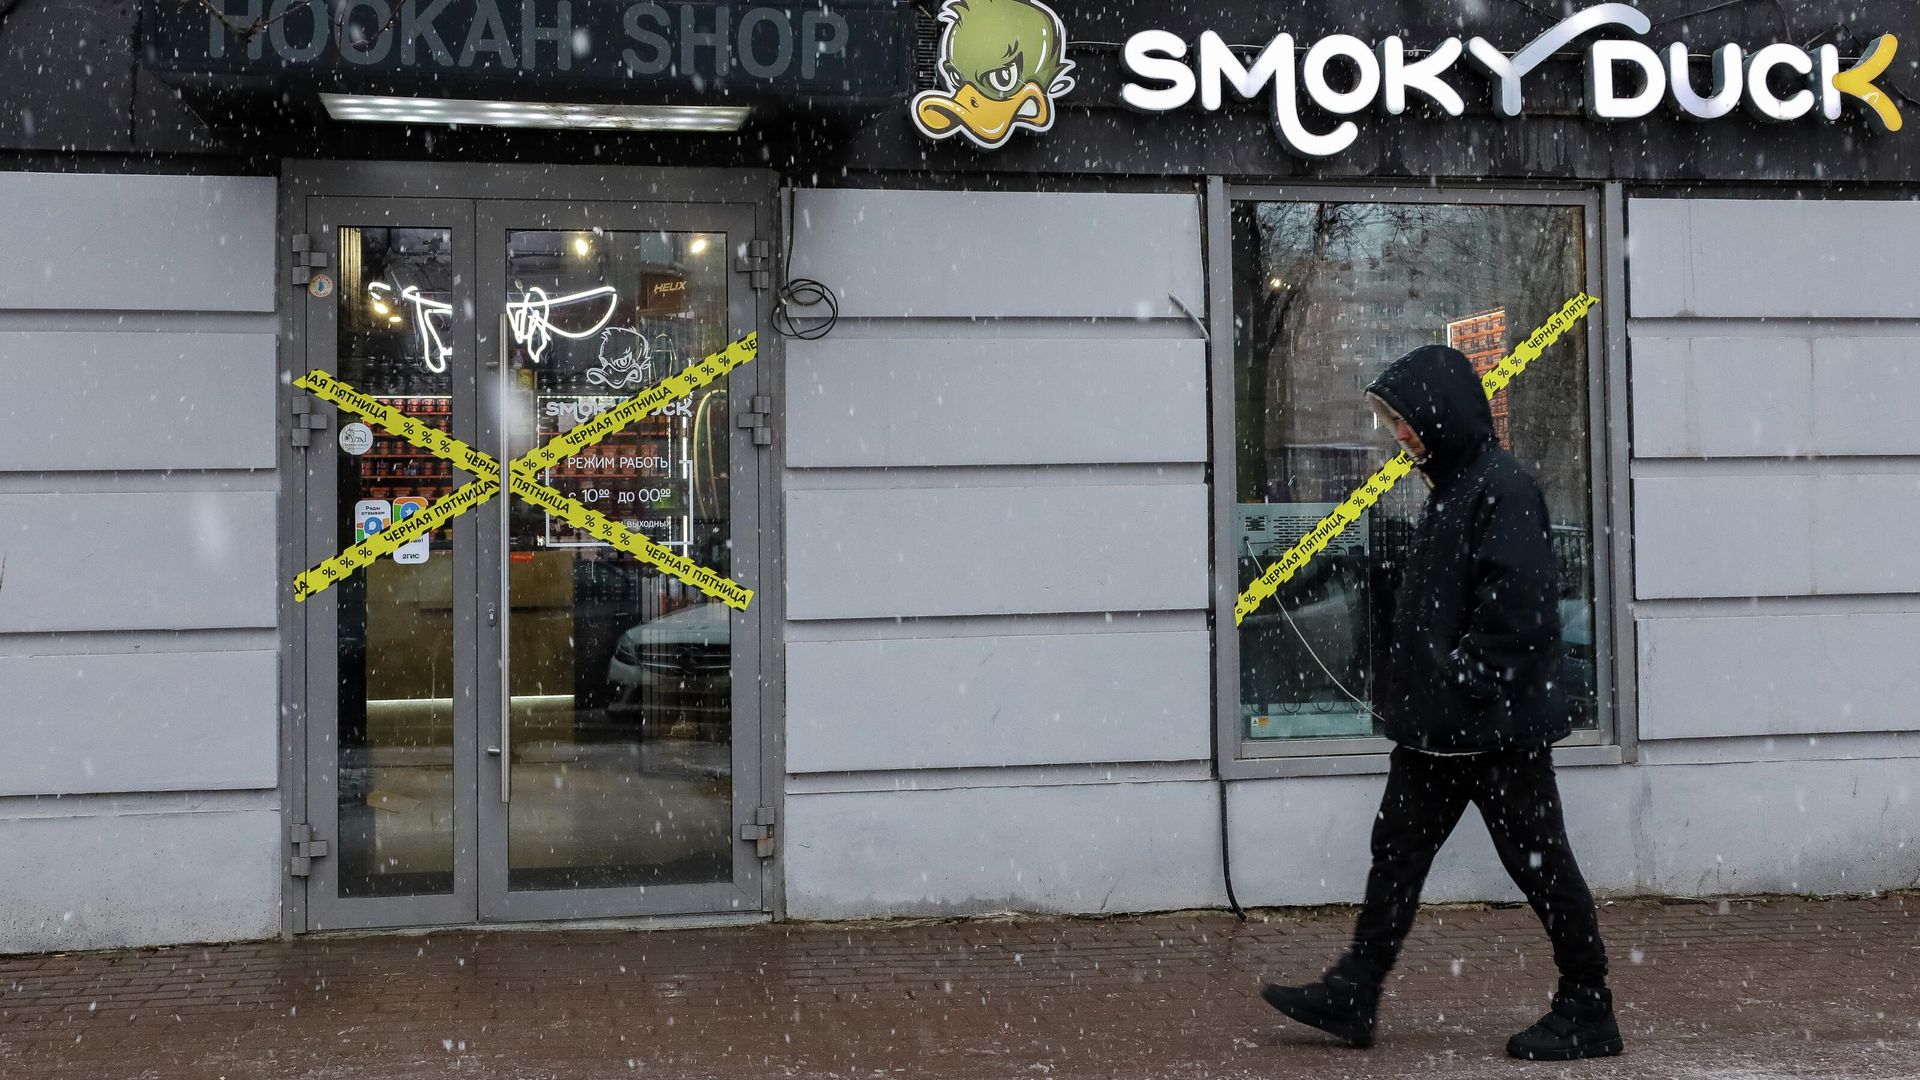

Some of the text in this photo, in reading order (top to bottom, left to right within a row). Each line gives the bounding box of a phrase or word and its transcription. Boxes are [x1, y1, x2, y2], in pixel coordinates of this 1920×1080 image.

[209, 0, 850, 80] HOOKAH SHOP
[1122, 3, 1899, 157] SMOKY DUCK
[654, 281, 688, 293] HELIX
[545, 401, 607, 423] SMOK
[1262, 553, 1301, 587] ЧЕРНАЯ
[1300, 513, 1346, 554] ПЯТНИЦА
[1528, 317, 1564, 349] ЧЕРНАЯ
[1563, 296, 1589, 320] ПЯТН
[329, 384, 388, 421] ПЯТНИЦА
[512, 477, 570, 514] ПЯТНИЦА
[645, 544, 691, 575] ЧЕРНАЯ
[692, 569, 747, 605] ПЯТНИЦА
[384, 512, 433, 542] ЧЕРНАЯ
[434, 481, 494, 518] ПЯТНИЦА
[565, 419, 613, 446] ЧЕРНАЯ
[615, 386, 673, 422] ПЯТНИЦА
[567, 457, 615, 469] РЕЖИМ
[618, 492, 635, 504] до
